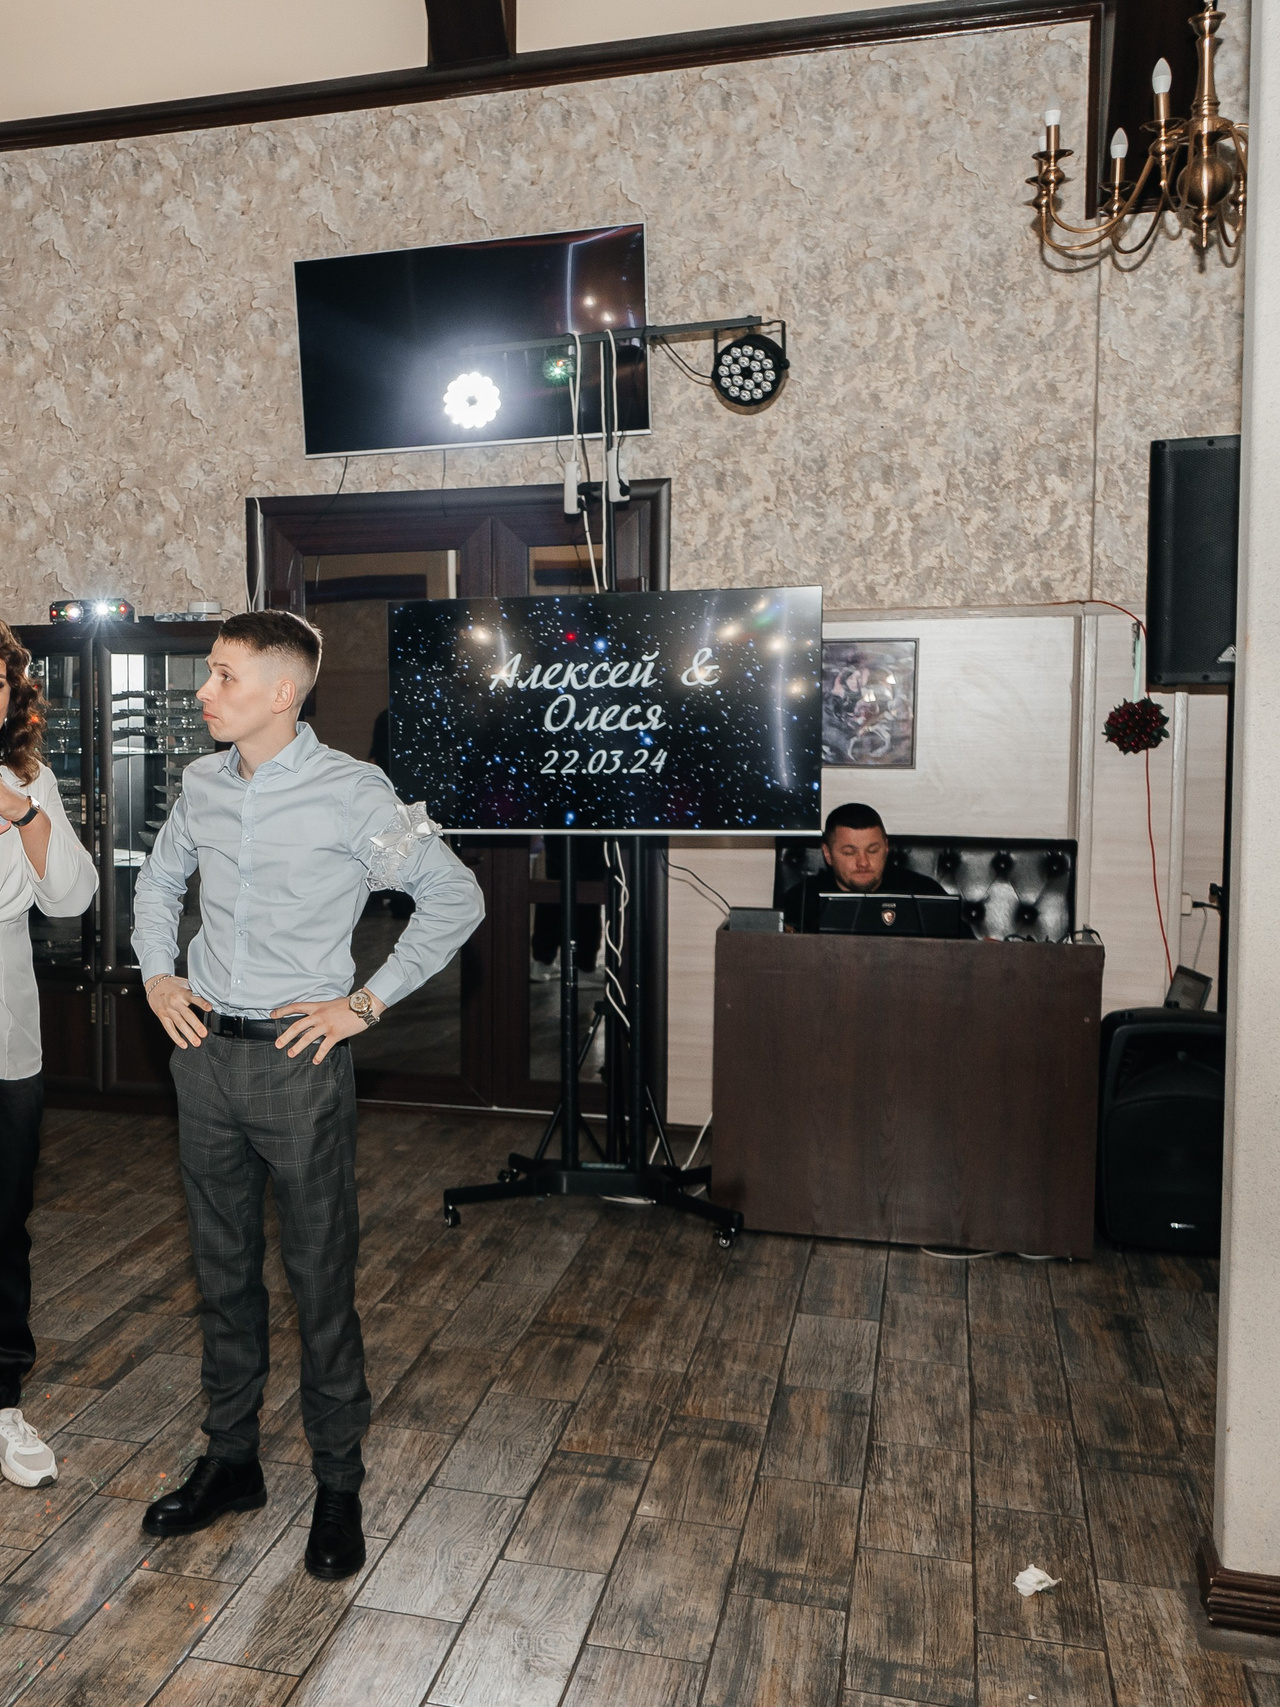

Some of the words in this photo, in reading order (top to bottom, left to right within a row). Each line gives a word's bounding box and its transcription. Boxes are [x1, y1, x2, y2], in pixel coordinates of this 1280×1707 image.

[489, 651, 660, 691] Алексей
[681, 647, 721, 687] &
[543, 693, 667, 732] Олеся
[540, 748, 669, 774] 22.03.24
